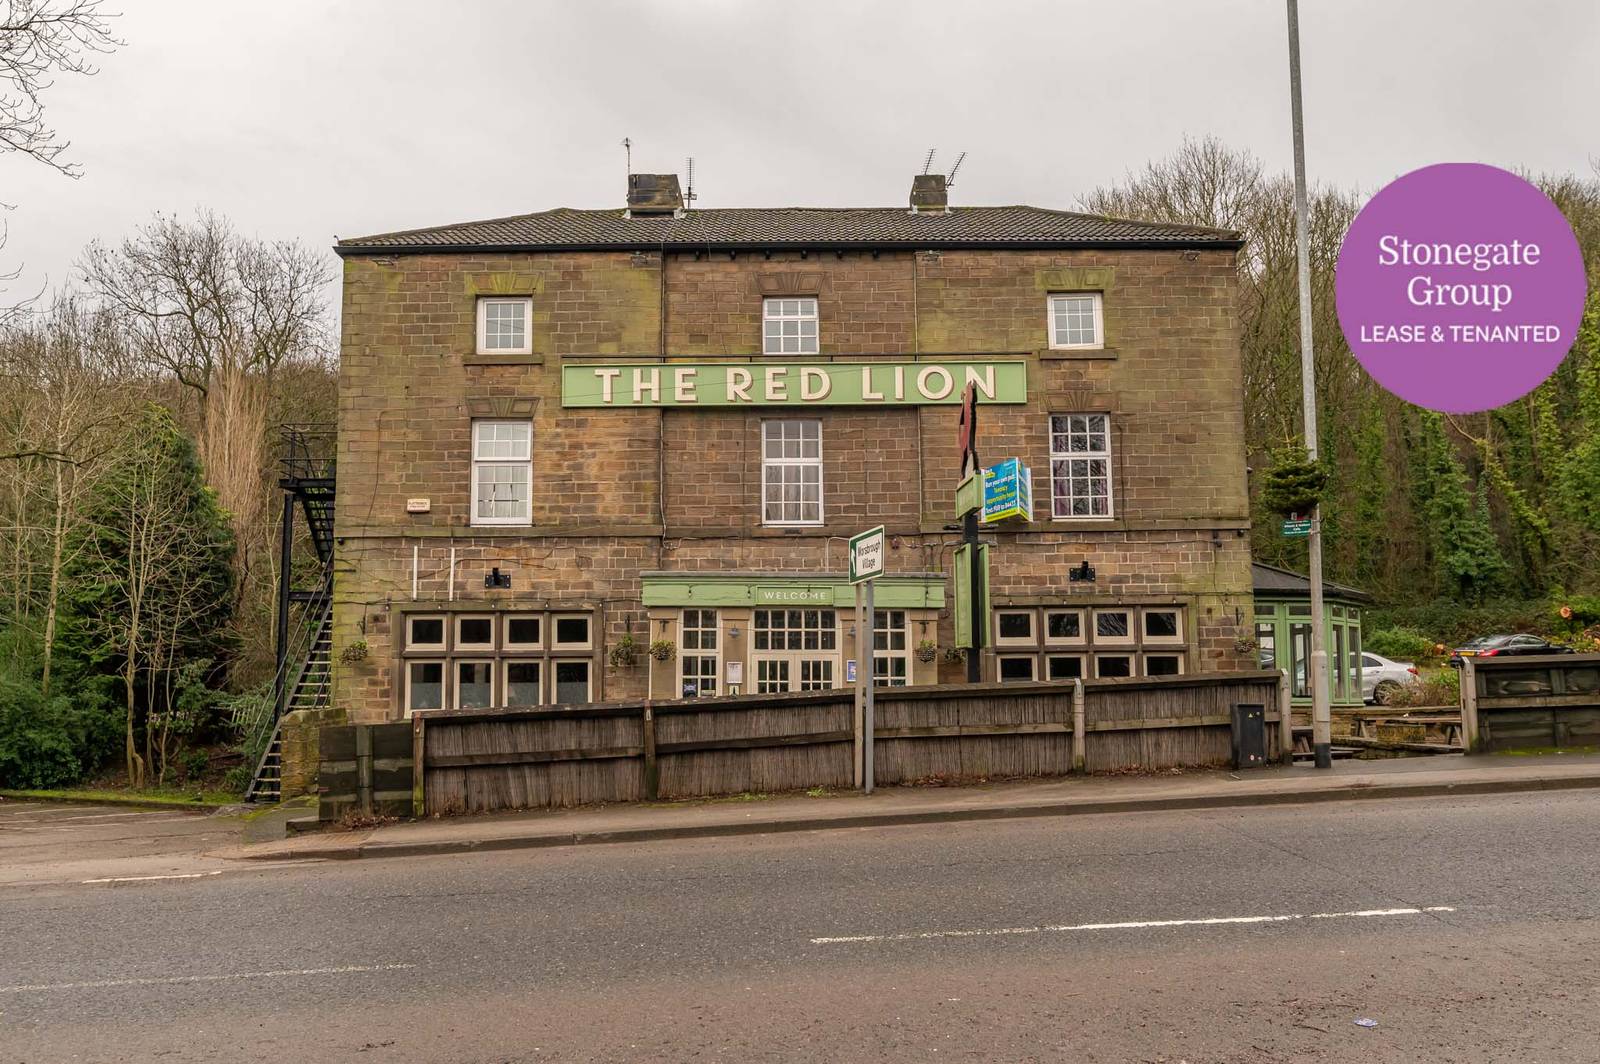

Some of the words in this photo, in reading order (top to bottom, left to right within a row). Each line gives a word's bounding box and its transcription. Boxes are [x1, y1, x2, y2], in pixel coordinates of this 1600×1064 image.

[594, 367, 698, 403] THE
[726, 365, 832, 402] RED
[862, 365, 996, 401] LION
[857, 539, 881, 557] Worsbrough
[862, 557, 876, 569] Village
[764, 591, 826, 600] WELCOME
